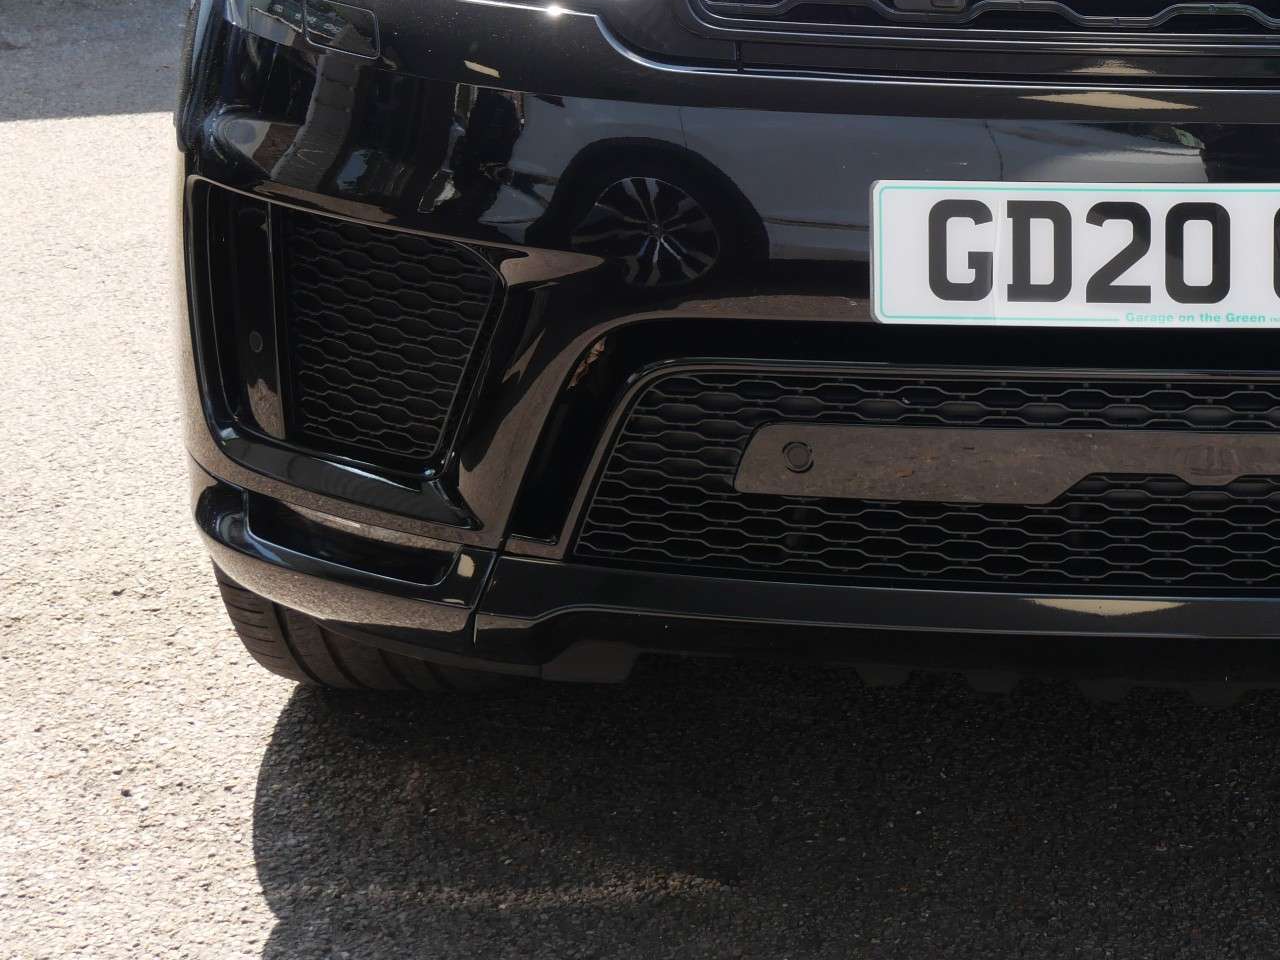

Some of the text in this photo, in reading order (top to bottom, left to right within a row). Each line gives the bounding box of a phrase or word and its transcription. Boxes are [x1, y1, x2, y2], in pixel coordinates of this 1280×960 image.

[928, 199, 1231, 304] GD20
[1125, 312, 1175, 324] Garage
[1178, 314, 1195, 323] on
[1199, 312, 1221, 323] the
[1225, 311, 1266, 323] Green
